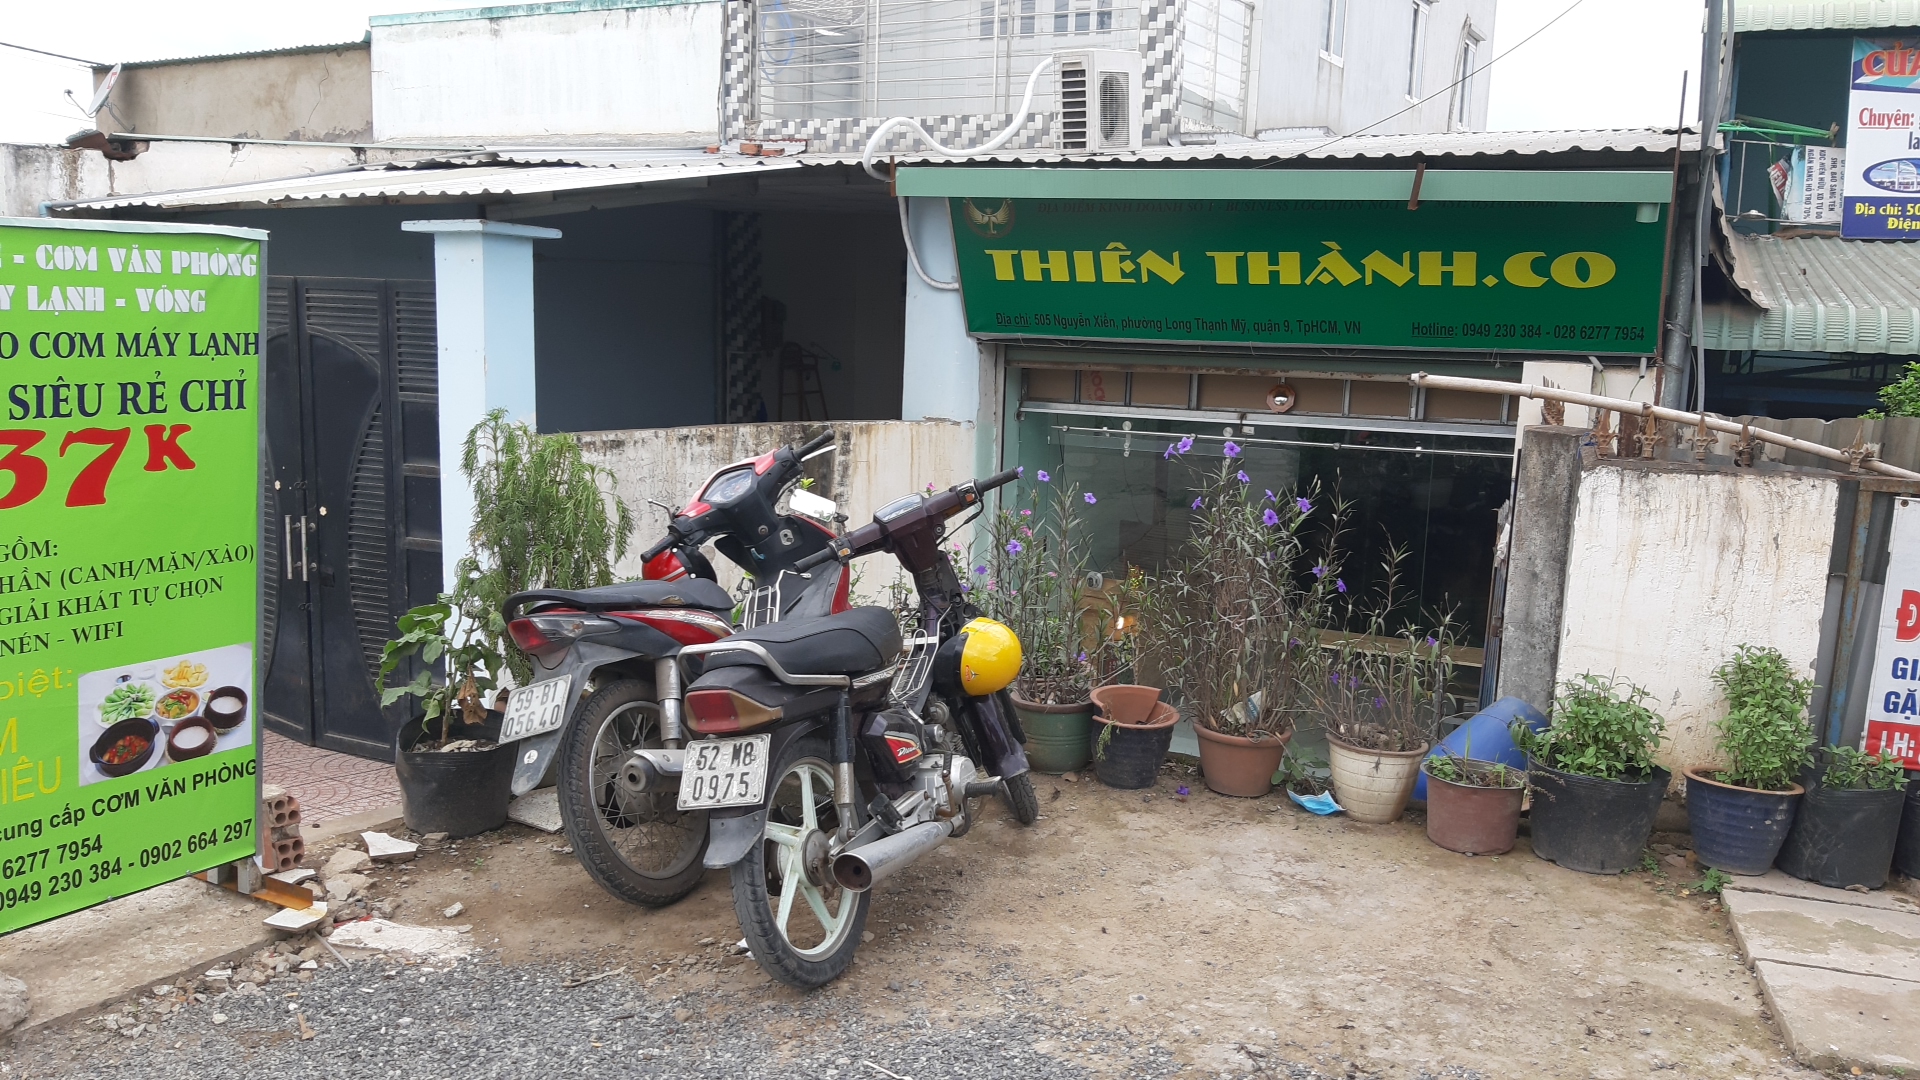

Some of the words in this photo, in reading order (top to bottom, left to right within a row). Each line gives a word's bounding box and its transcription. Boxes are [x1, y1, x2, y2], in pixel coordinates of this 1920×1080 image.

[1859, 107, 1914, 130] Chuyên:
[1855, 202, 1876, 217] Địa
[1879, 202, 1902, 215] chỉ:
[1887, 217, 1920, 232] Điện
[35, 244, 98, 272] CƠM
[107, 244, 162, 274] VĂN
[171, 247, 257, 277] PHÒNG
[984, 242, 1185, 285] THIÊN
[1205, 241, 1616, 288] THÀNH.CO
[27, 285, 105, 316] LẠNH
[996, 313, 1012, 326] Địa
[1034, 313, 1050, 326] 505
[1053, 313, 1091, 330] Nguyễn
[1121, 317, 1163, 332] phường
[1165, 317, 1192, 333] Long
[1194, 317, 1228, 333] Thạnh
[1231, 318, 1250, 334] Mỹ,
[1253, 319, 1280, 336] quận
[1283, 320, 1293, 334] 9,
[1296, 320, 1341, 336] TpHCM,
[1344, 321, 1361, 334] VN
[1411, 322, 1458, 338] Hotline:
[1462, 323, 1491, 337] 0949
[1494, 323, 1516, 338] 230
[1520, 324, 1541, 338] 384
[1553, 325, 1576, 339] 028
[1580, 325, 1611, 340] 6277
[1614, 326, 1645, 341] 7954
[29, 331, 106, 359] CƠM
[116, 327, 183, 358] MÁY
[188, 332, 259, 361] LẠNH
[8, 376, 105, 421] SIÊU
[117, 370, 168, 416] RẺ
[179, 368, 247, 413] CHỈ
[60, 544, 255, 590] (CANH/MẶN/XÀO)
[0, 597, 50, 626] GIẢI
[57, 590, 123, 618] KHÁT
[129, 585, 160, 607] TỰ
[164, 576, 224, 599] CHỌN
[71, 620, 124, 645] WIFI
[504, 703, 560, 738] 056.40
[1883, 688, 1920, 720] GẶ
[0, 818, 43, 843] ung
[49, 802, 86, 830] cấp
[91, 789, 140, 818] CƠM
[146, 777, 187, 803] VĂN
[192, 758, 257, 791] PHÒNG
[692, 772, 750, 801] 0975
[2, 847, 50, 880] 6277
[56, 834, 103, 864] 7954
[48, 868, 83, 897] 230
[88, 856, 123, 885] 384
[139, 838, 183, 869] 0902
[187, 828, 218, 854] 664
[223, 818, 253, 845] 297
